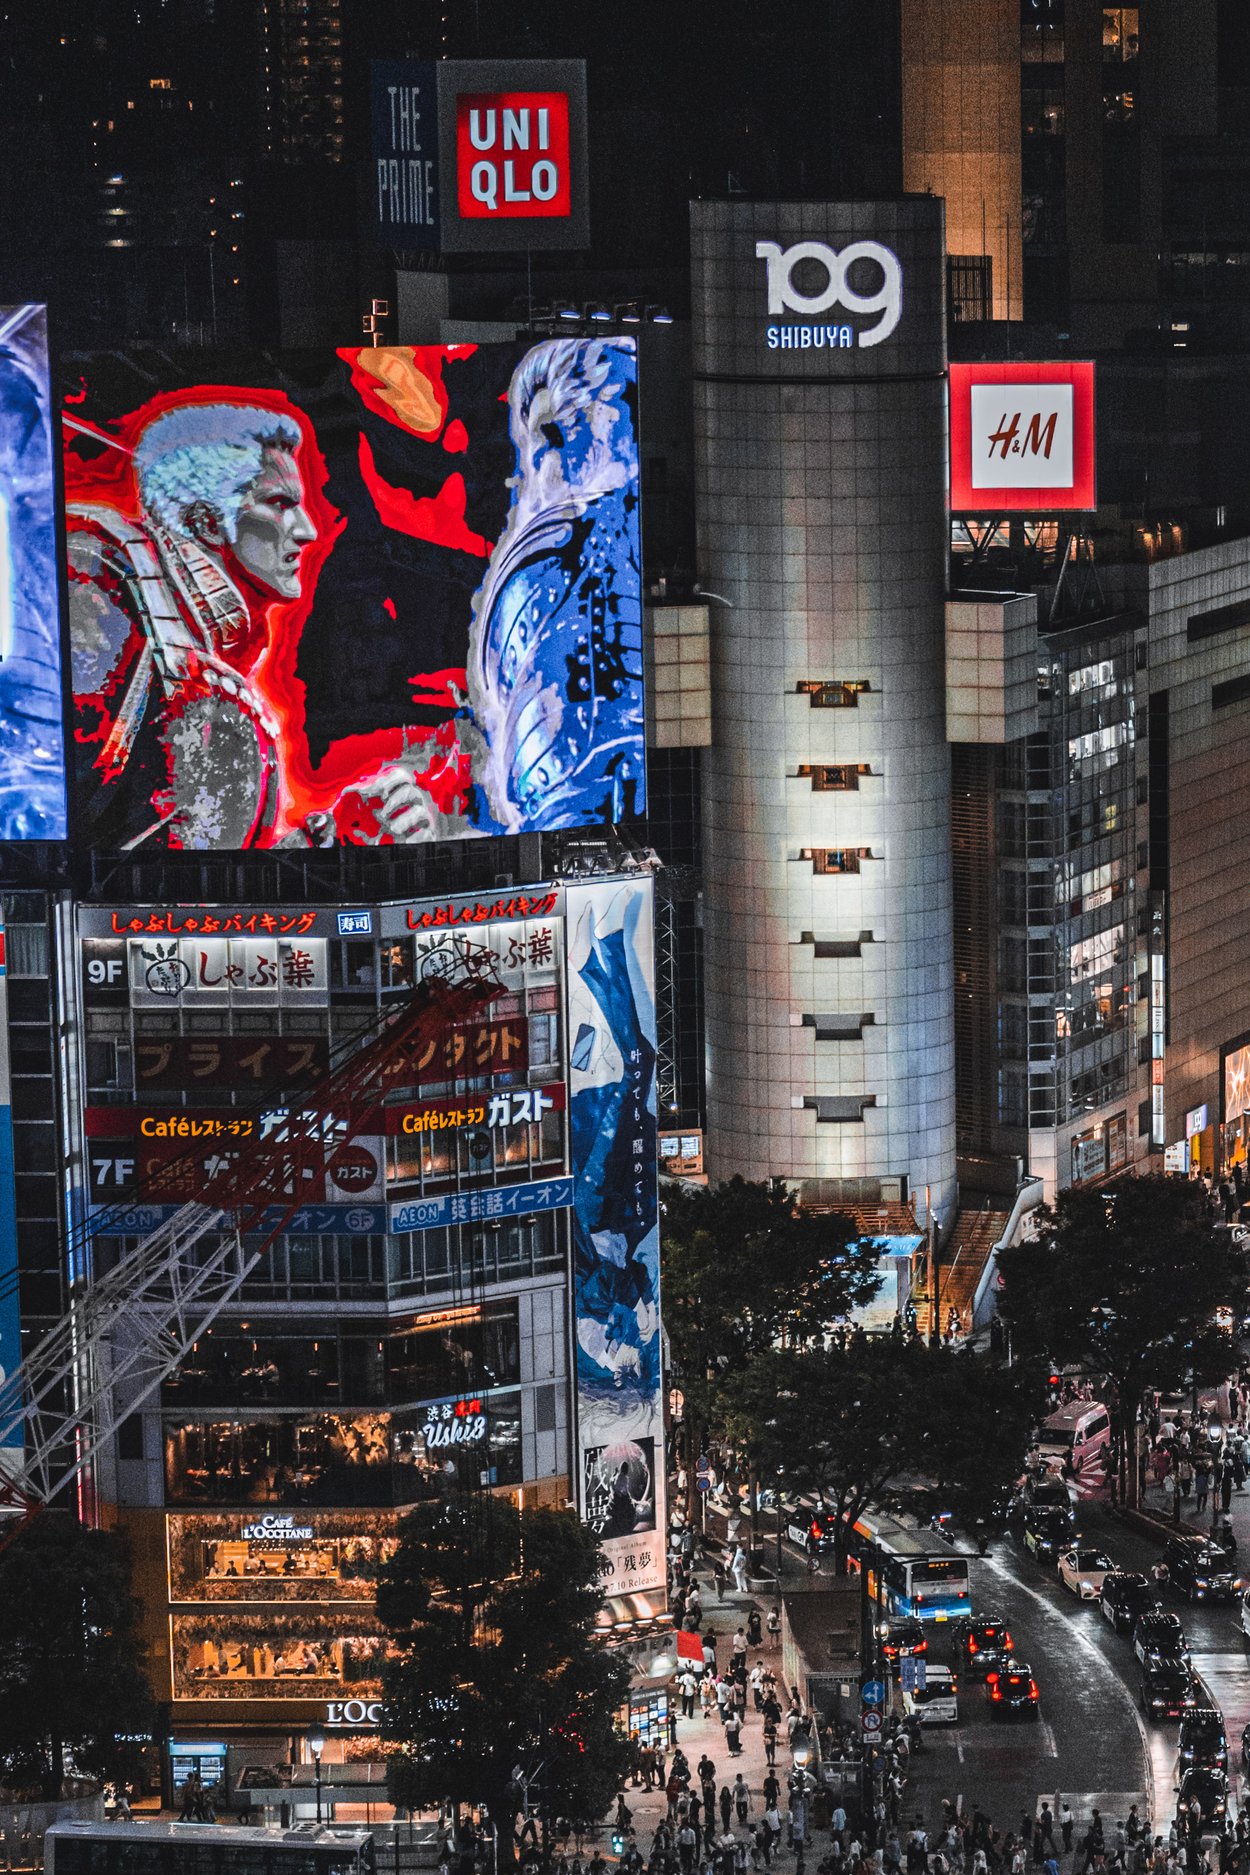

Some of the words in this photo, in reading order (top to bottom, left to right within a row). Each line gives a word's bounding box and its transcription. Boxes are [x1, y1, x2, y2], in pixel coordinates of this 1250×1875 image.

[388, 86, 421, 151] THE
[469, 109, 551, 151] UNI
[378, 159, 434, 226] PRIME
[471, 160, 559, 210] QLO
[756, 240, 903, 348] 109
[768, 325, 852, 350] SHIBUYA
[988, 412, 1059, 461] H&M
[111, 912, 317, 934] しゃぶしゃぶバイキング
[341, 914, 370, 932] 寿司
[407, 892, 558, 930] しゃぶしゃぶバイキング
[88, 960, 122, 984] 9F
[200, 950, 315, 988] しゃぶ葉
[488, 1090, 553, 1129] ガスト
[93, 1158, 135, 1185] 7F
[398, 1204, 443, 1227] AEON
[628, 1575, 658, 1589] Release
